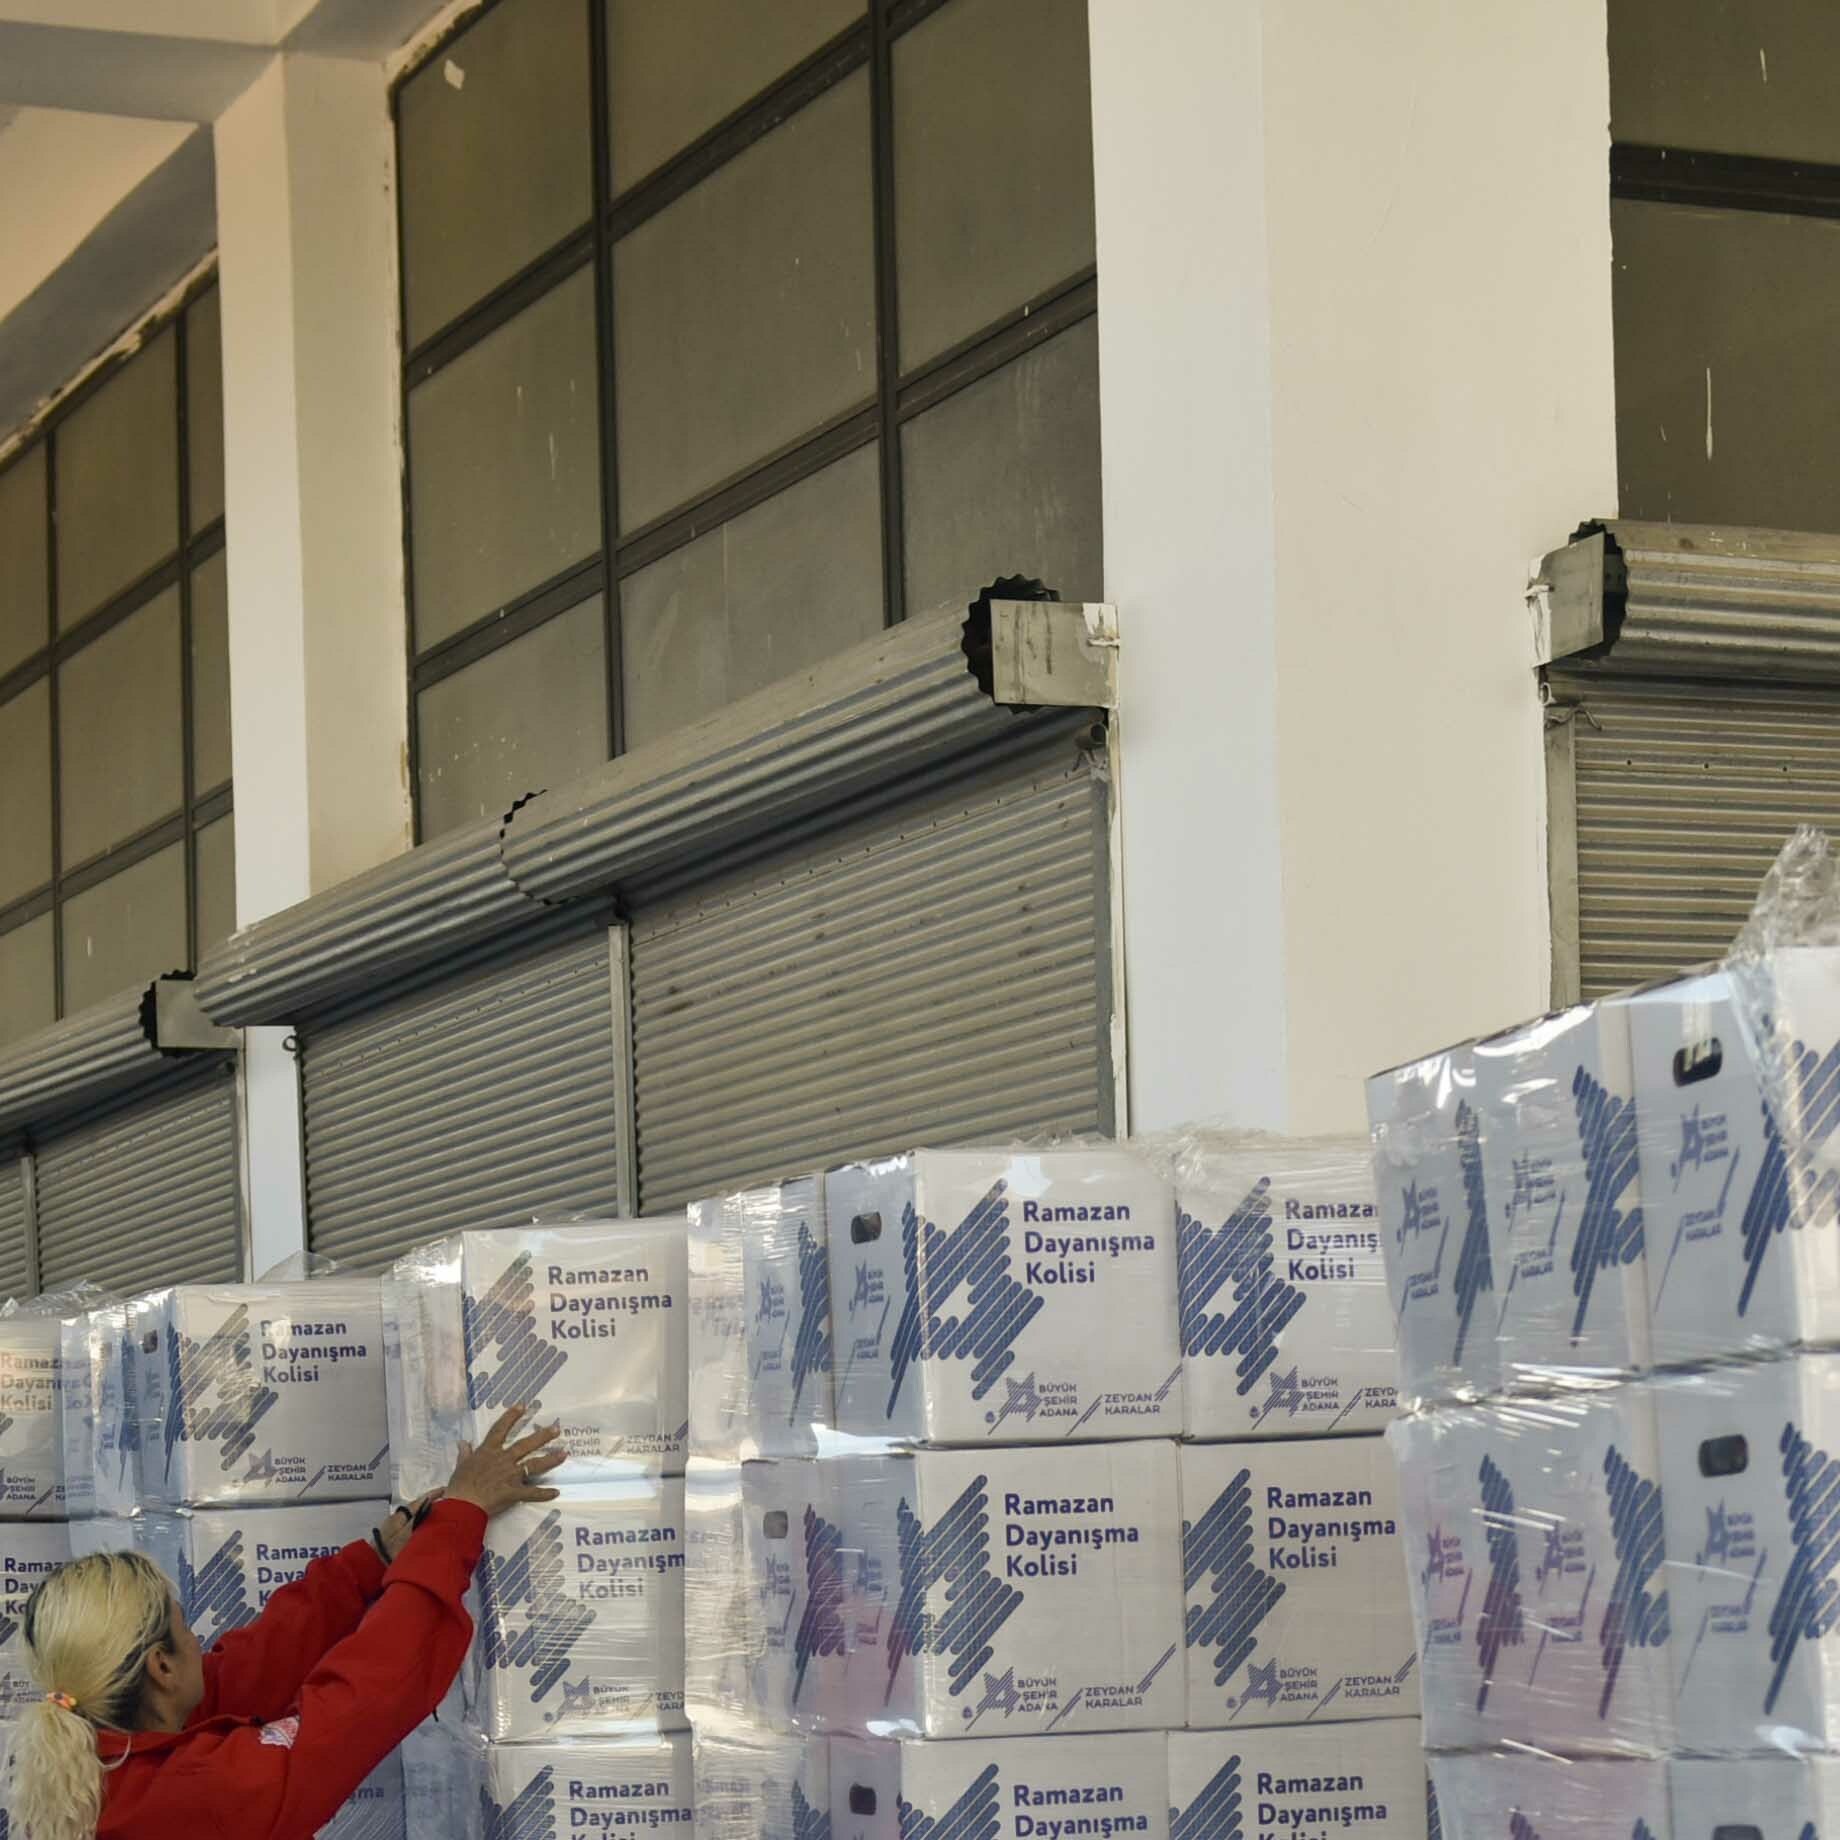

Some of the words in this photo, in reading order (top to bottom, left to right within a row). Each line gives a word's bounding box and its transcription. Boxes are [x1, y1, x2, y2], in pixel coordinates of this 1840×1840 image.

[1023, 1201, 1129, 1222] Ramazan
[1286, 1198, 1378, 1219] Ramaza
[1025, 1232, 1154, 1258] Dayanışma
[1287, 1228, 1378, 1255] Dayanış
[548, 1266, 648, 1285] Ramazan
[1027, 1262, 1094, 1284] Kolisi
[1289, 1257, 1354, 1280] Kolisi
[551, 1294, 672, 1316] Dayanışma
[552, 1318, 615, 1339] Kolisi
[263, 1343, 366, 1363] Dayanışma
[264, 1365, 318, 1383] Kolisi
[1039, 1383, 1077, 1393] BÜYÜK
[1104, 1393, 1153, 1403] ZEYDAN
[1040, 1408, 1078, 1417] ADANA
[1104, 1405, 1161, 1415] KARALAR
[1005, 1494, 1113, 1515] Ramazan
[1267, 1487, 1371, 1508] Ramazan
[576, 1527, 675, 1546] Ramazan
[1006, 1524, 1138, 1551] Dayanışma
[1269, 1517, 1395, 1543] Dayanışma
[577, 1553, 686, 1576] Dayanışm
[1007, 1554, 1076, 1577] Kolisi
[1270, 1546, 1336, 1569] Kolisi
[579, 1577, 643, 1599] Kolisi
[569, 1781, 668, 1800] Ramazan
[1258, 1773, 1363, 1794] Ramazan
[1014, 1785, 1122, 1806] Ramazan
[570, 1807, 692, 1830] Dayanışma
[1258, 1803, 1386, 1829] Dayanışma
[1015, 1815, 1147, 1840] Dayanışma
